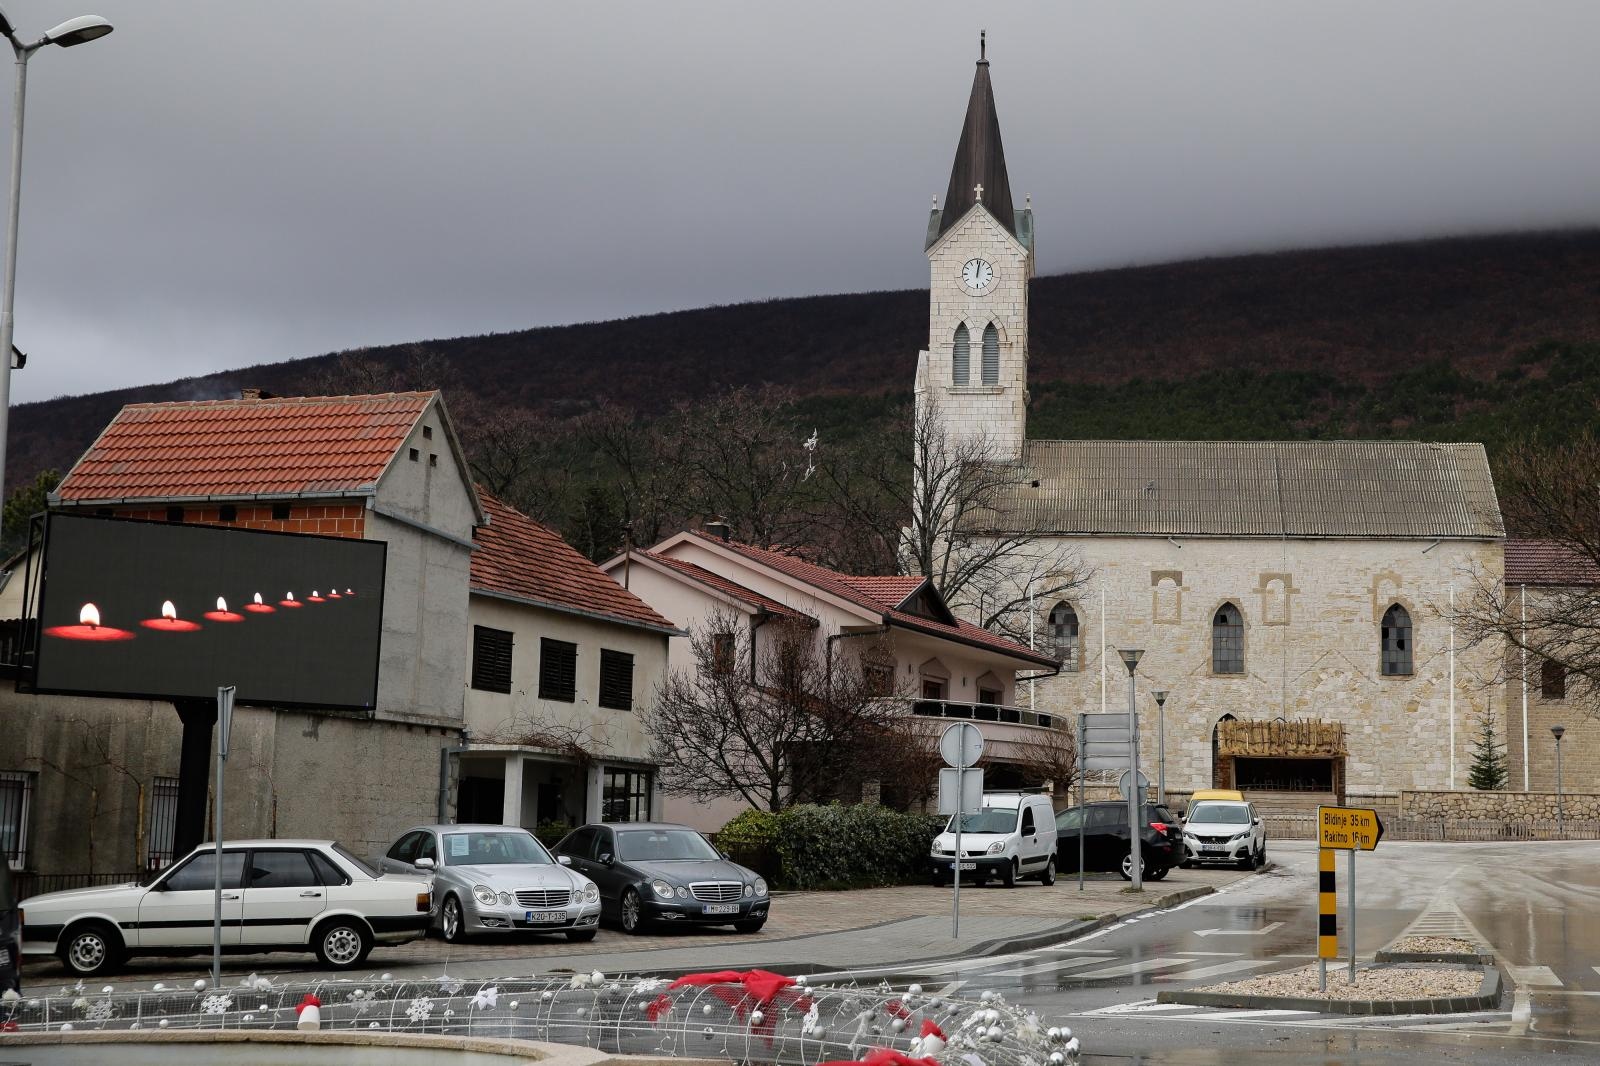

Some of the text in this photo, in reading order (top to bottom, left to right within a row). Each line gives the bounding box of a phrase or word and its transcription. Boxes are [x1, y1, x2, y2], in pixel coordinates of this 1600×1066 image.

[1324, 812, 1370, 829] Blidinje 35 km
[1324, 830, 1370, 844] Rakitno 16 km
